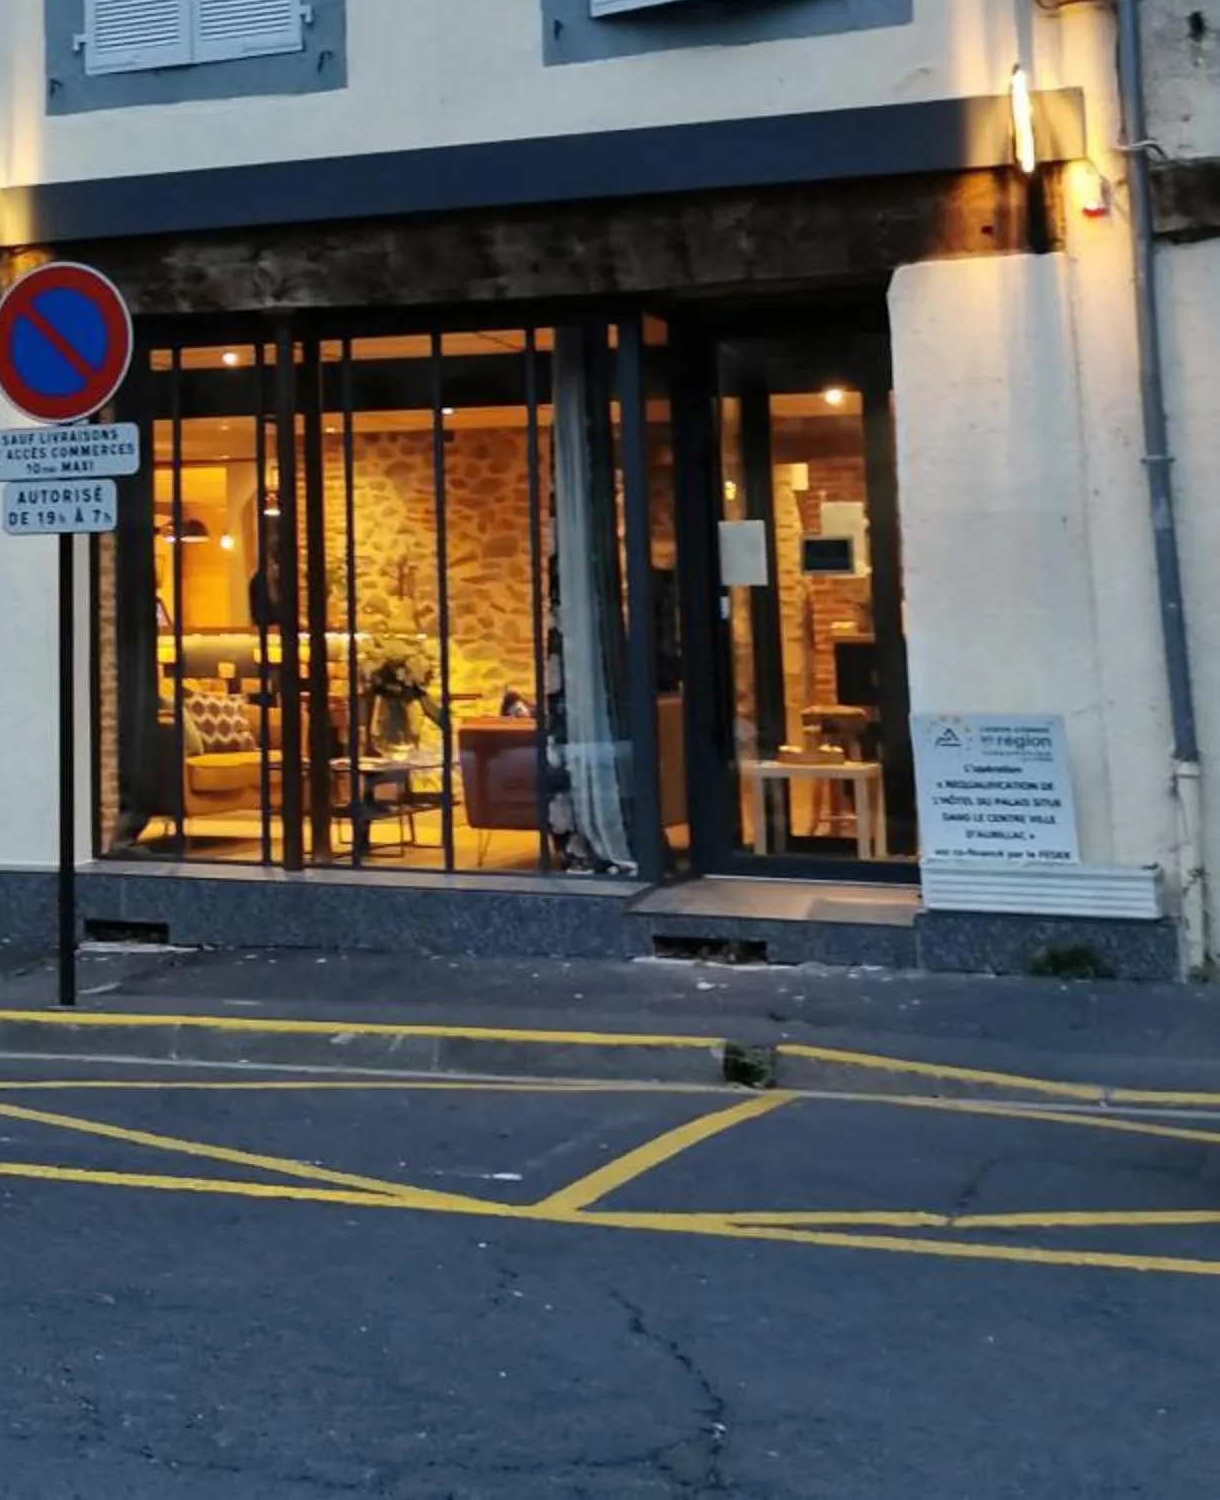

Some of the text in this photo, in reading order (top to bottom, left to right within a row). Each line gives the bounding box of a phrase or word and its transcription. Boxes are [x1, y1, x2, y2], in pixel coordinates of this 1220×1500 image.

[1, 429, 119, 446] SAUF LIVRAISONS
[6, 445, 48, 461] ACCÈS
[50, 442, 135, 459] COMMERCES
[61, 461, 95, 473] MAXI
[16, 485, 104, 505] AUTORISÉ
[8, 511, 29, 526] DE
[996, 732, 1053, 749] région
